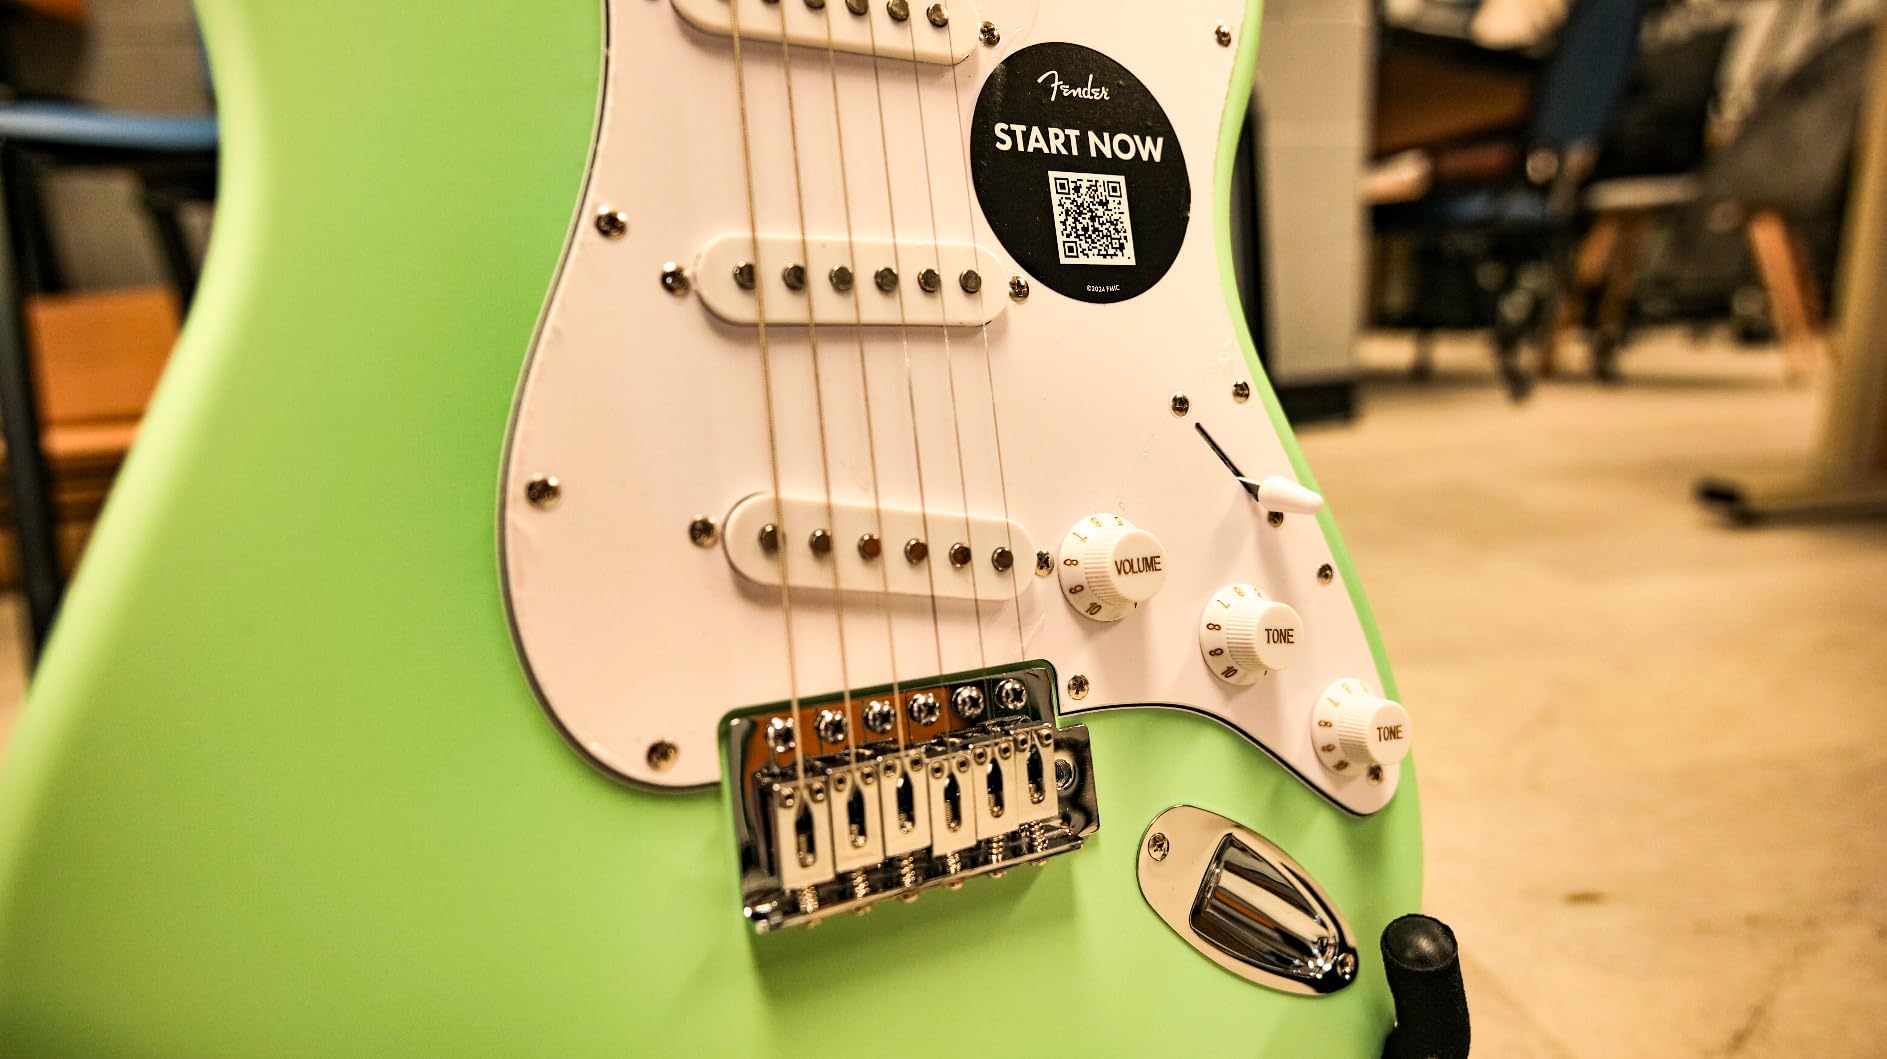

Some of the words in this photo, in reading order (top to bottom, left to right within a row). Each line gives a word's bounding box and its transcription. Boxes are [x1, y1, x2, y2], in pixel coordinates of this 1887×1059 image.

[1037, 70, 1110, 101] Fender
[994, 122, 1080, 156] START
[1087, 130, 1164, 163] NOW
[1063, 558, 1078, 567] 8
[1114, 555, 1162, 576] VOLUME
[1069, 584, 1085, 594] 9
[1085, 602, 1102, 616] 10
[1206, 622, 1222, 631] 8
[1264, 628, 1295, 644] TONE
[1208, 647, 1224, 657] 9
[1221, 665, 1238, 678] 10
[1318, 720, 1333, 728] 8
[1376, 724, 1404, 742] TONE
